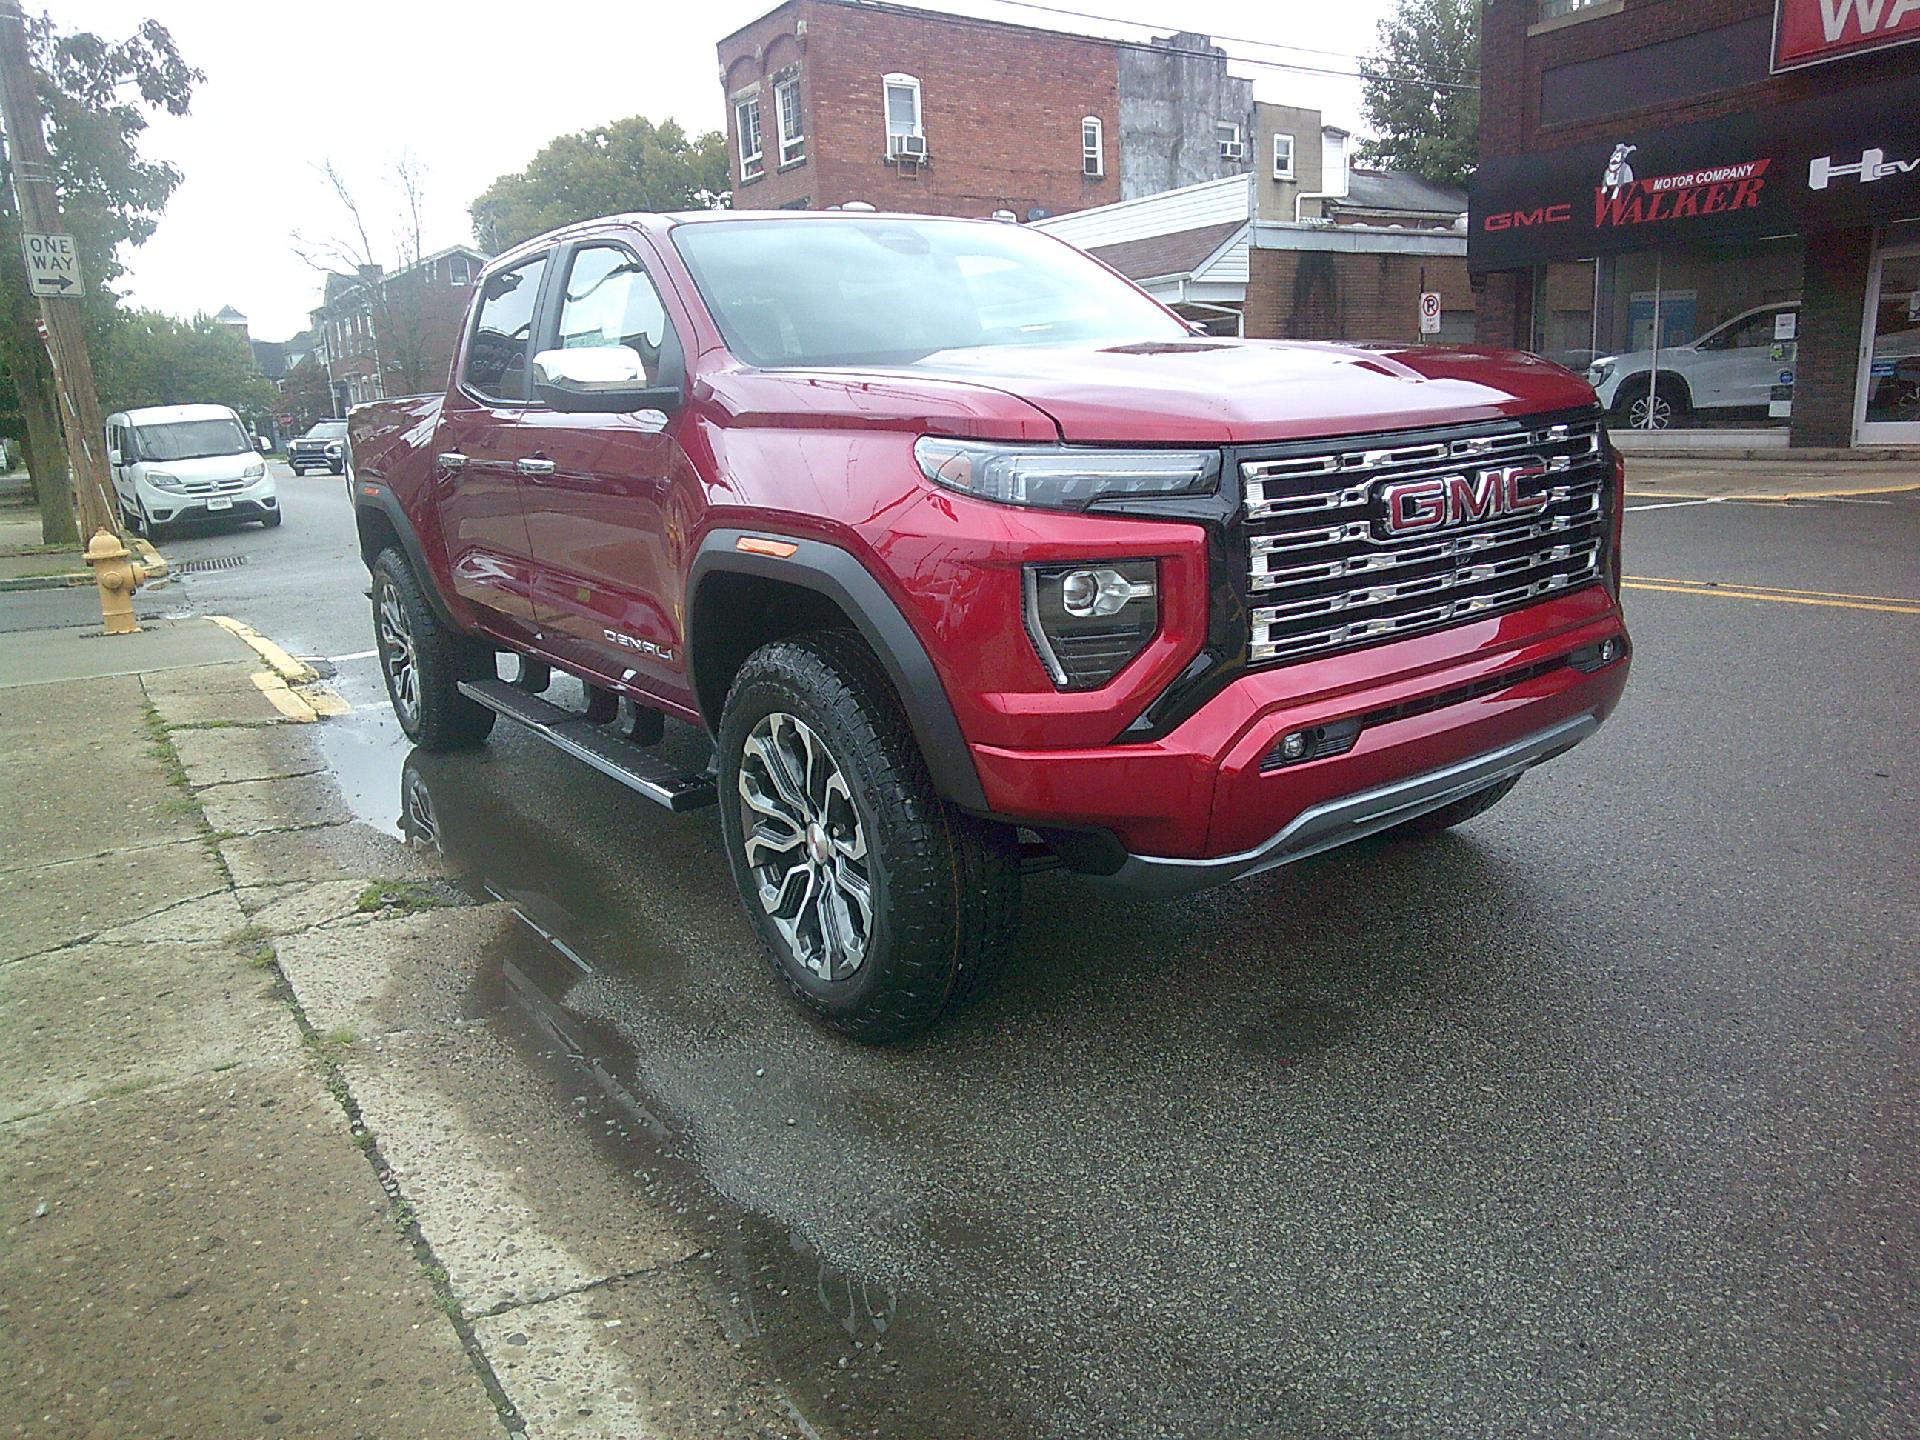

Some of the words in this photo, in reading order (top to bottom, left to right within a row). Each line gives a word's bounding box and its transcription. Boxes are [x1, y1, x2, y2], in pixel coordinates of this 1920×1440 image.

[1653, 175, 1693, 190] MOTOR
[1695, 164, 1755, 184] COMPANY
[1594, 178, 1766, 228] WALKER
[1484, 204, 1571, 231] GMC
[30, 238, 71, 254] ONE
[32, 255, 73, 271] WAY
[1382, 466, 1547, 536] GMC
[603, 629, 674, 661] DENALI
